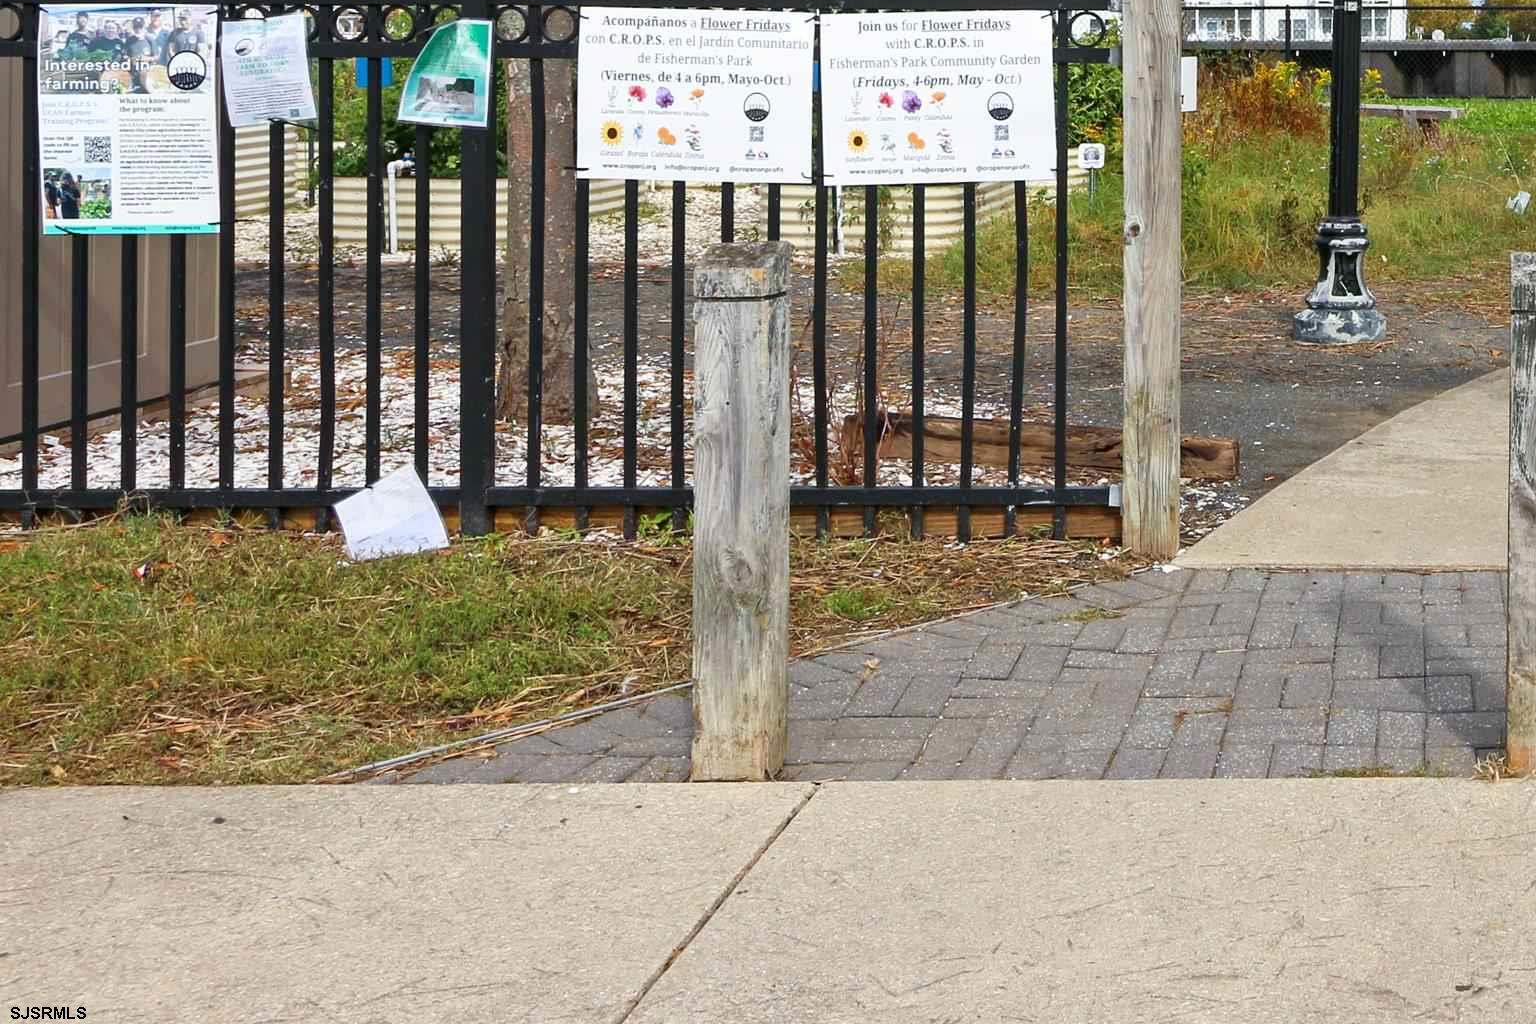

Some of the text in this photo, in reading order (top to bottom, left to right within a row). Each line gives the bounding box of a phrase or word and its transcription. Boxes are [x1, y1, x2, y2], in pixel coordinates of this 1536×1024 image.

[602, 15, 687, 28] Acompáñanos
[701, 17, 743, 31] Flower
[747, 19, 790, 32] Fridays
[858, 18, 1011, 34] Join us for Flower Fridays
[585, 35, 605, 43] con
[610, 34, 665, 45] C.R.O.P.S.
[686, 36, 695, 46] el
[738, 38, 808, 49] Comunitario
[886, 38, 984, 49] with C.R.O.P.S. in
[45, 60, 150, 72] Interested in
[638, 55, 752, 66] de Fisherman's Park
[902, 57, 927, 68] Park
[931, 55, 996, 68] Community
[1000, 54, 1040, 65] Garden
[601, 70, 654, 82] (Viernes,
[658, 73, 672, 82] de
[675, 72, 682, 82] 4
[684, 75, 691, 83] a
[695, 73, 724, 85] 6pm,
[853, 76, 909, 88] (Fridays,
[913, 76, 953, 88] 4-6pm,
[958, 75, 984, 87] May
[44, 78, 119, 93] farming?
